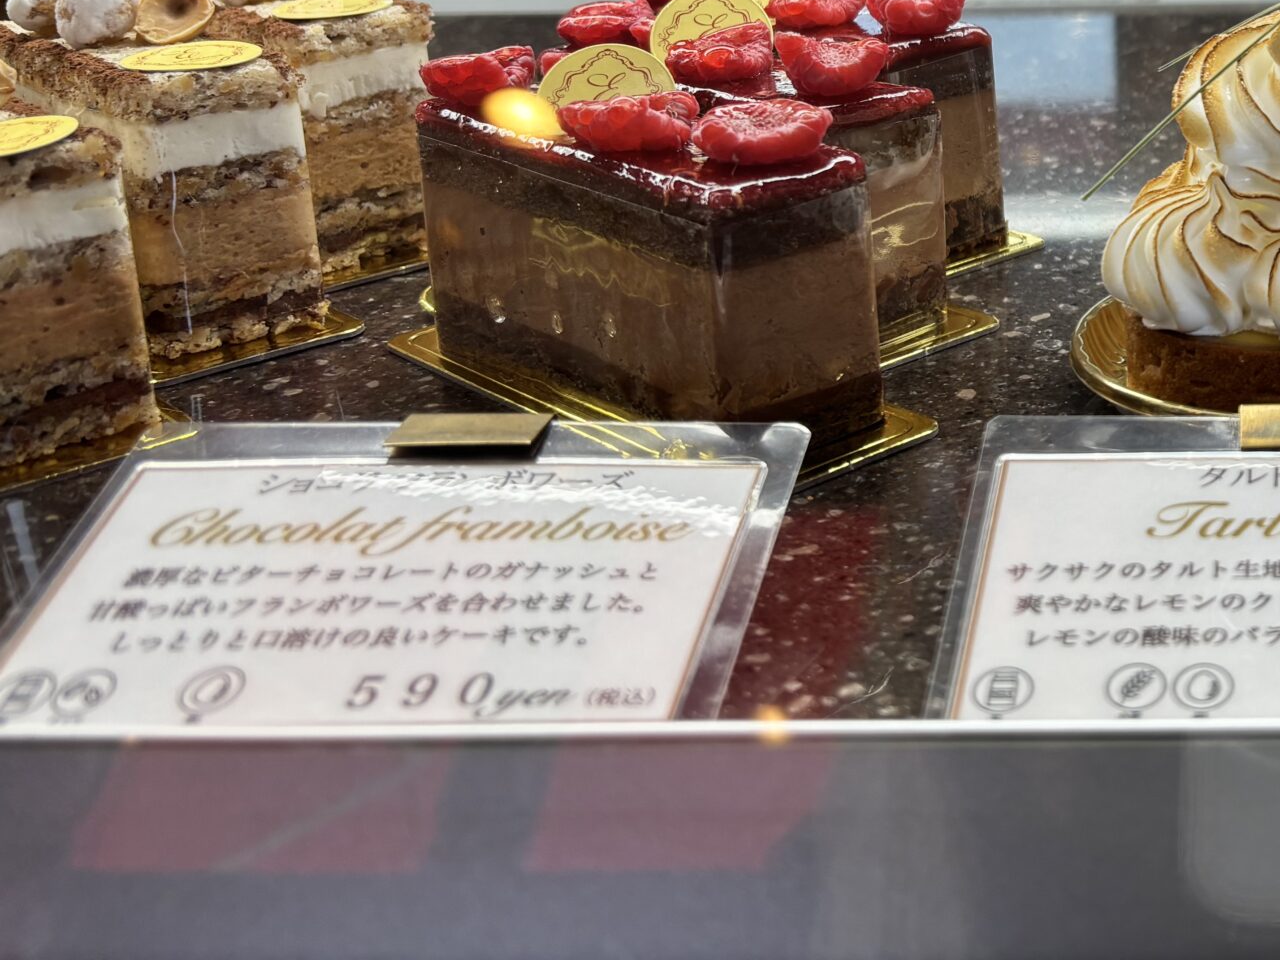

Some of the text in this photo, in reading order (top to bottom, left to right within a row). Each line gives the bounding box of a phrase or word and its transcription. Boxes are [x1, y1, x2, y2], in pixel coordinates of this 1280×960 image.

[148, 505, 692, 558] Chocolat framboise
[123, 562, 658, 588] 濃厚なビターチョコレートのガナッシュと
